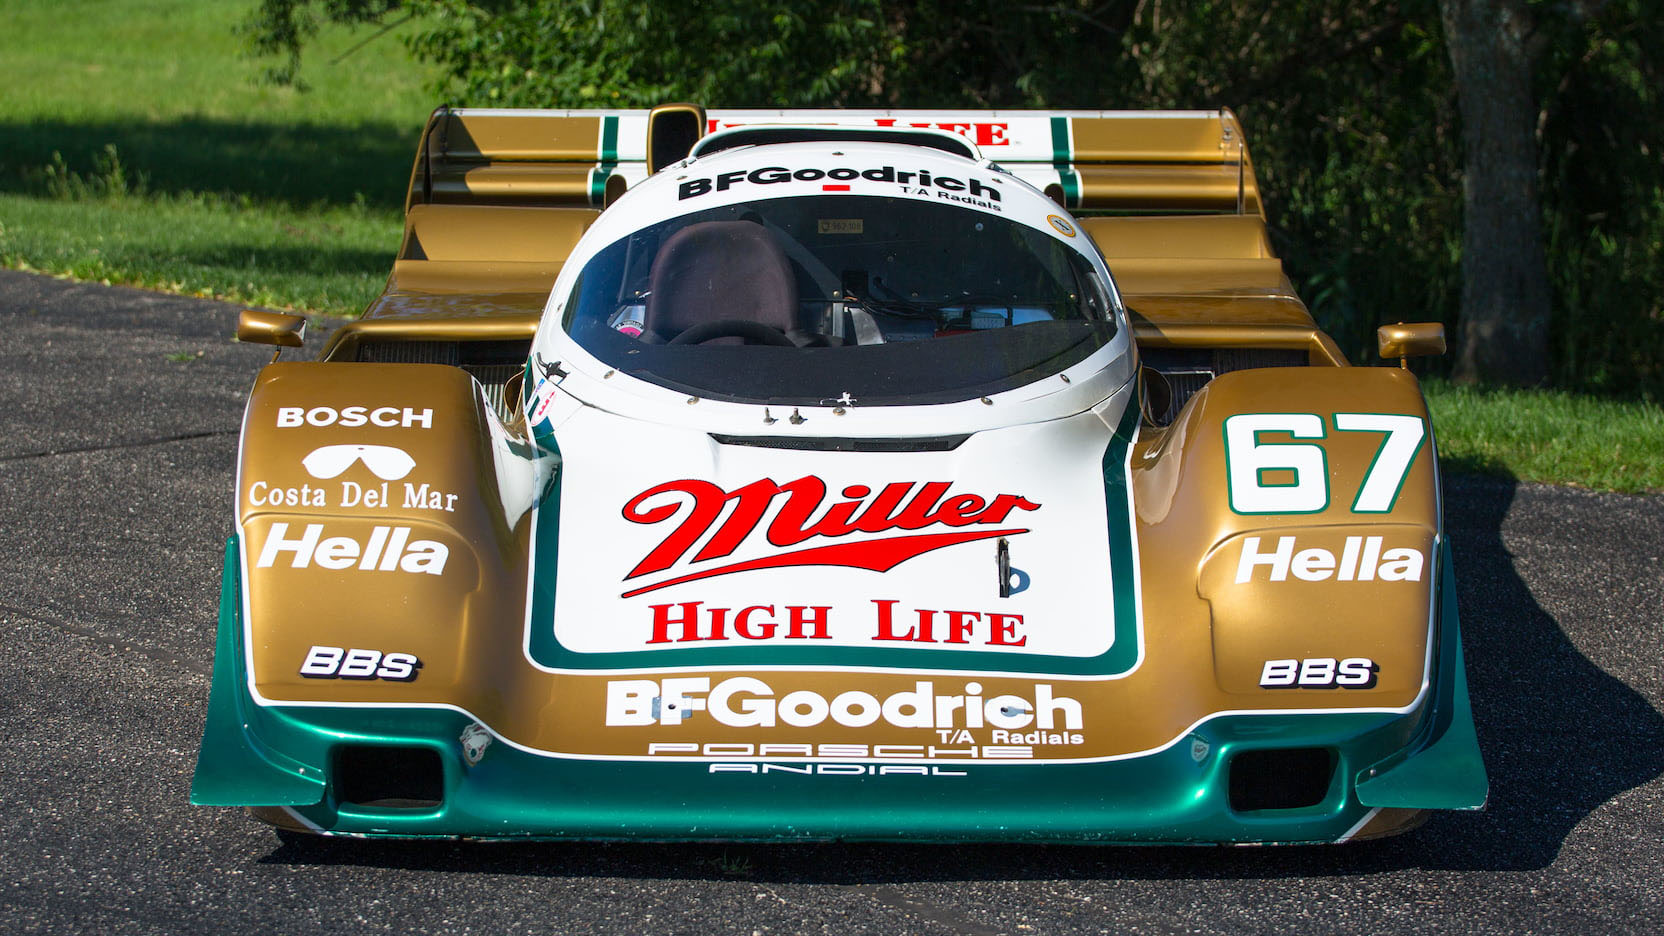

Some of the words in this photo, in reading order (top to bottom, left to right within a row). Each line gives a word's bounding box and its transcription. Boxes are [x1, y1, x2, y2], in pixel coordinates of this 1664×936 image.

[678, 166, 1001, 202] BFGoodrich
[900, 186, 929, 196] T/A
[938, 191, 1002, 212] Radials
[277, 406, 433, 429] BOSCH
[1222, 412, 1428, 516] 67
[249, 481, 326, 507] Costa
[340, 481, 388, 508] Del
[402, 482, 458, 512] Mar
[622, 475, 1042, 581] Miller
[256, 522, 449, 575] Hella
[1234, 536, 1424, 584] Hella
[645, 601, 833, 645] HIGH
[871, 600, 1028, 647] LIFE
[300, 646, 421, 681] BBS
[1259, 657, 1376, 688] BBS
[606, 676, 1083, 730] BFGoodrich
[648, 743, 1033, 758] PORSCHE
[936, 730, 975, 744] T/A
[992, 729, 1085, 745] Radials
[709, 763, 968, 776] ANDIAL
